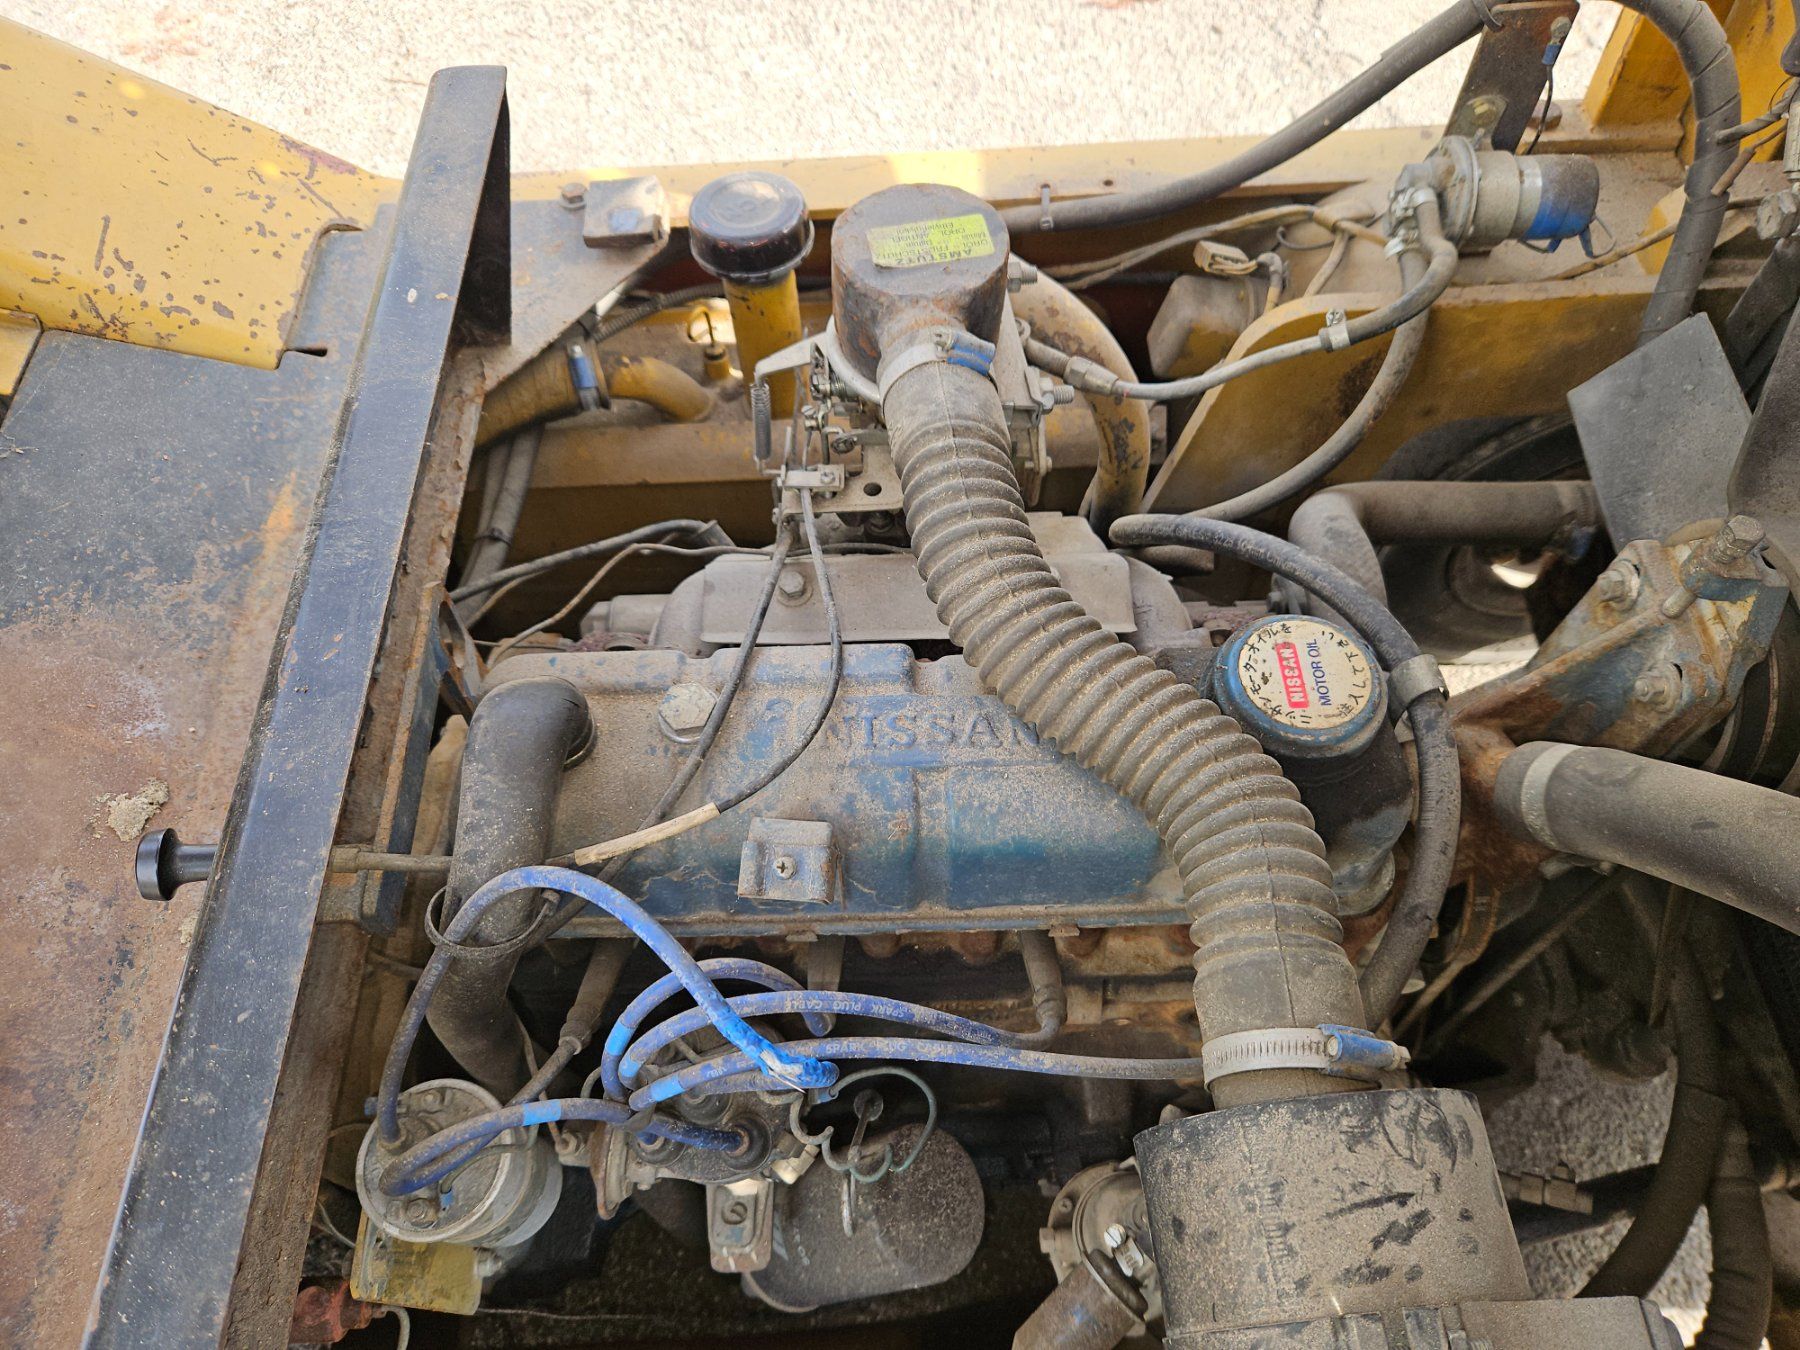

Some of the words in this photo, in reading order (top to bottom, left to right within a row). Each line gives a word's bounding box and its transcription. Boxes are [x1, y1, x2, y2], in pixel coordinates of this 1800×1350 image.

[896, 249, 972, 265] AMSTUTZ
[1306, 638, 1321, 658] OIL
[1279, 646, 1306, 702] NISSAN
[1310, 661, 1332, 706] MOTOR
[824, 713, 1041, 750] NISSAN
[784, 999, 823, 1013] CABLE
[833, 1000, 862, 1011] PLUG
[871, 1003, 905, 1018] SPARK
[825, 1041, 865, 1054] SPARK
